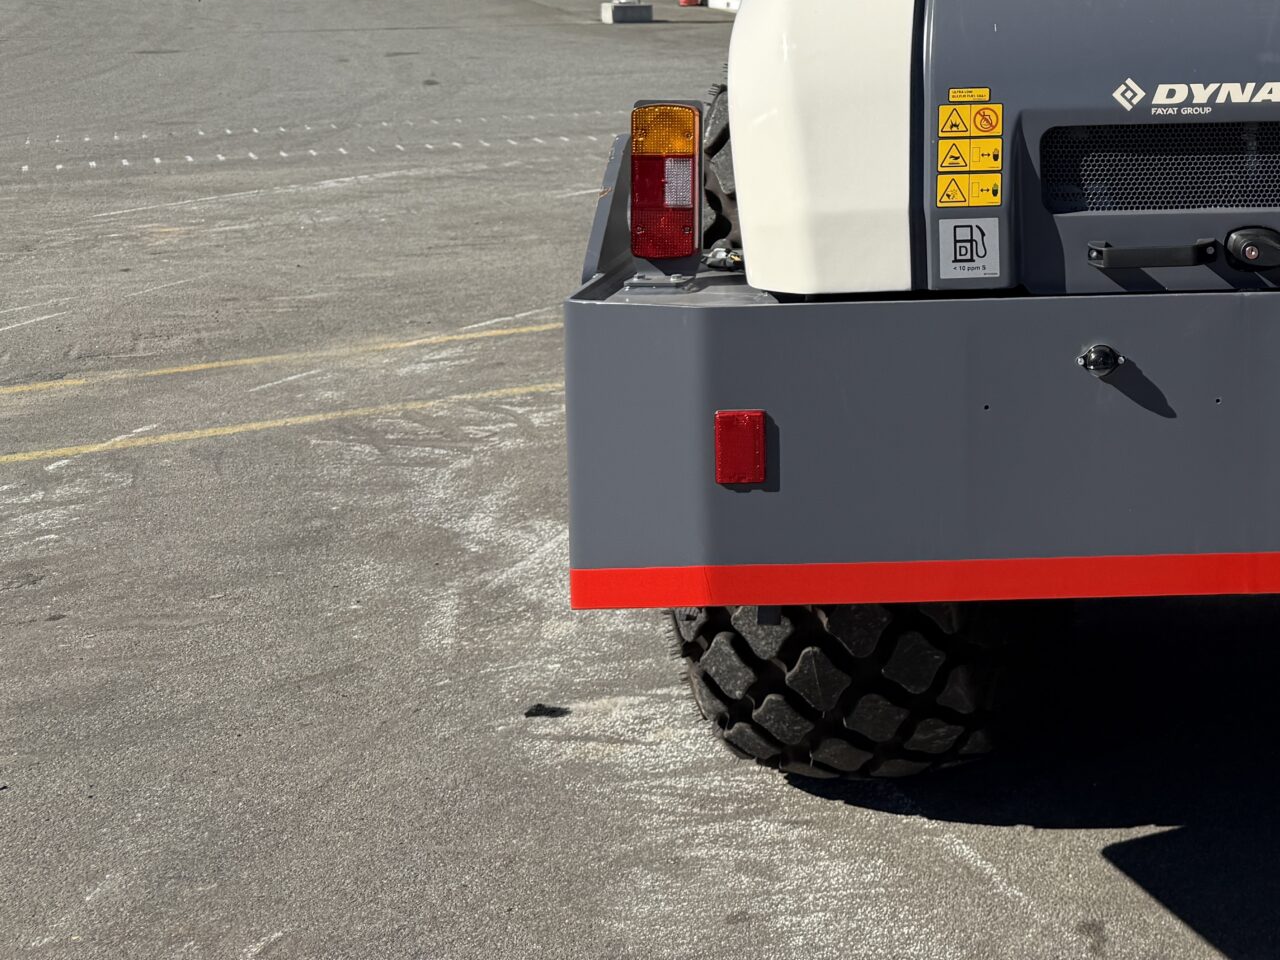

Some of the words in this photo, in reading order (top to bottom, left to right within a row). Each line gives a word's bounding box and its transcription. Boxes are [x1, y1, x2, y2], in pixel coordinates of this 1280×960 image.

[1151, 107, 1178, 115] FAYAT
[1181, 106, 1212, 115] GROUP
[958, 245, 968, 257] D
